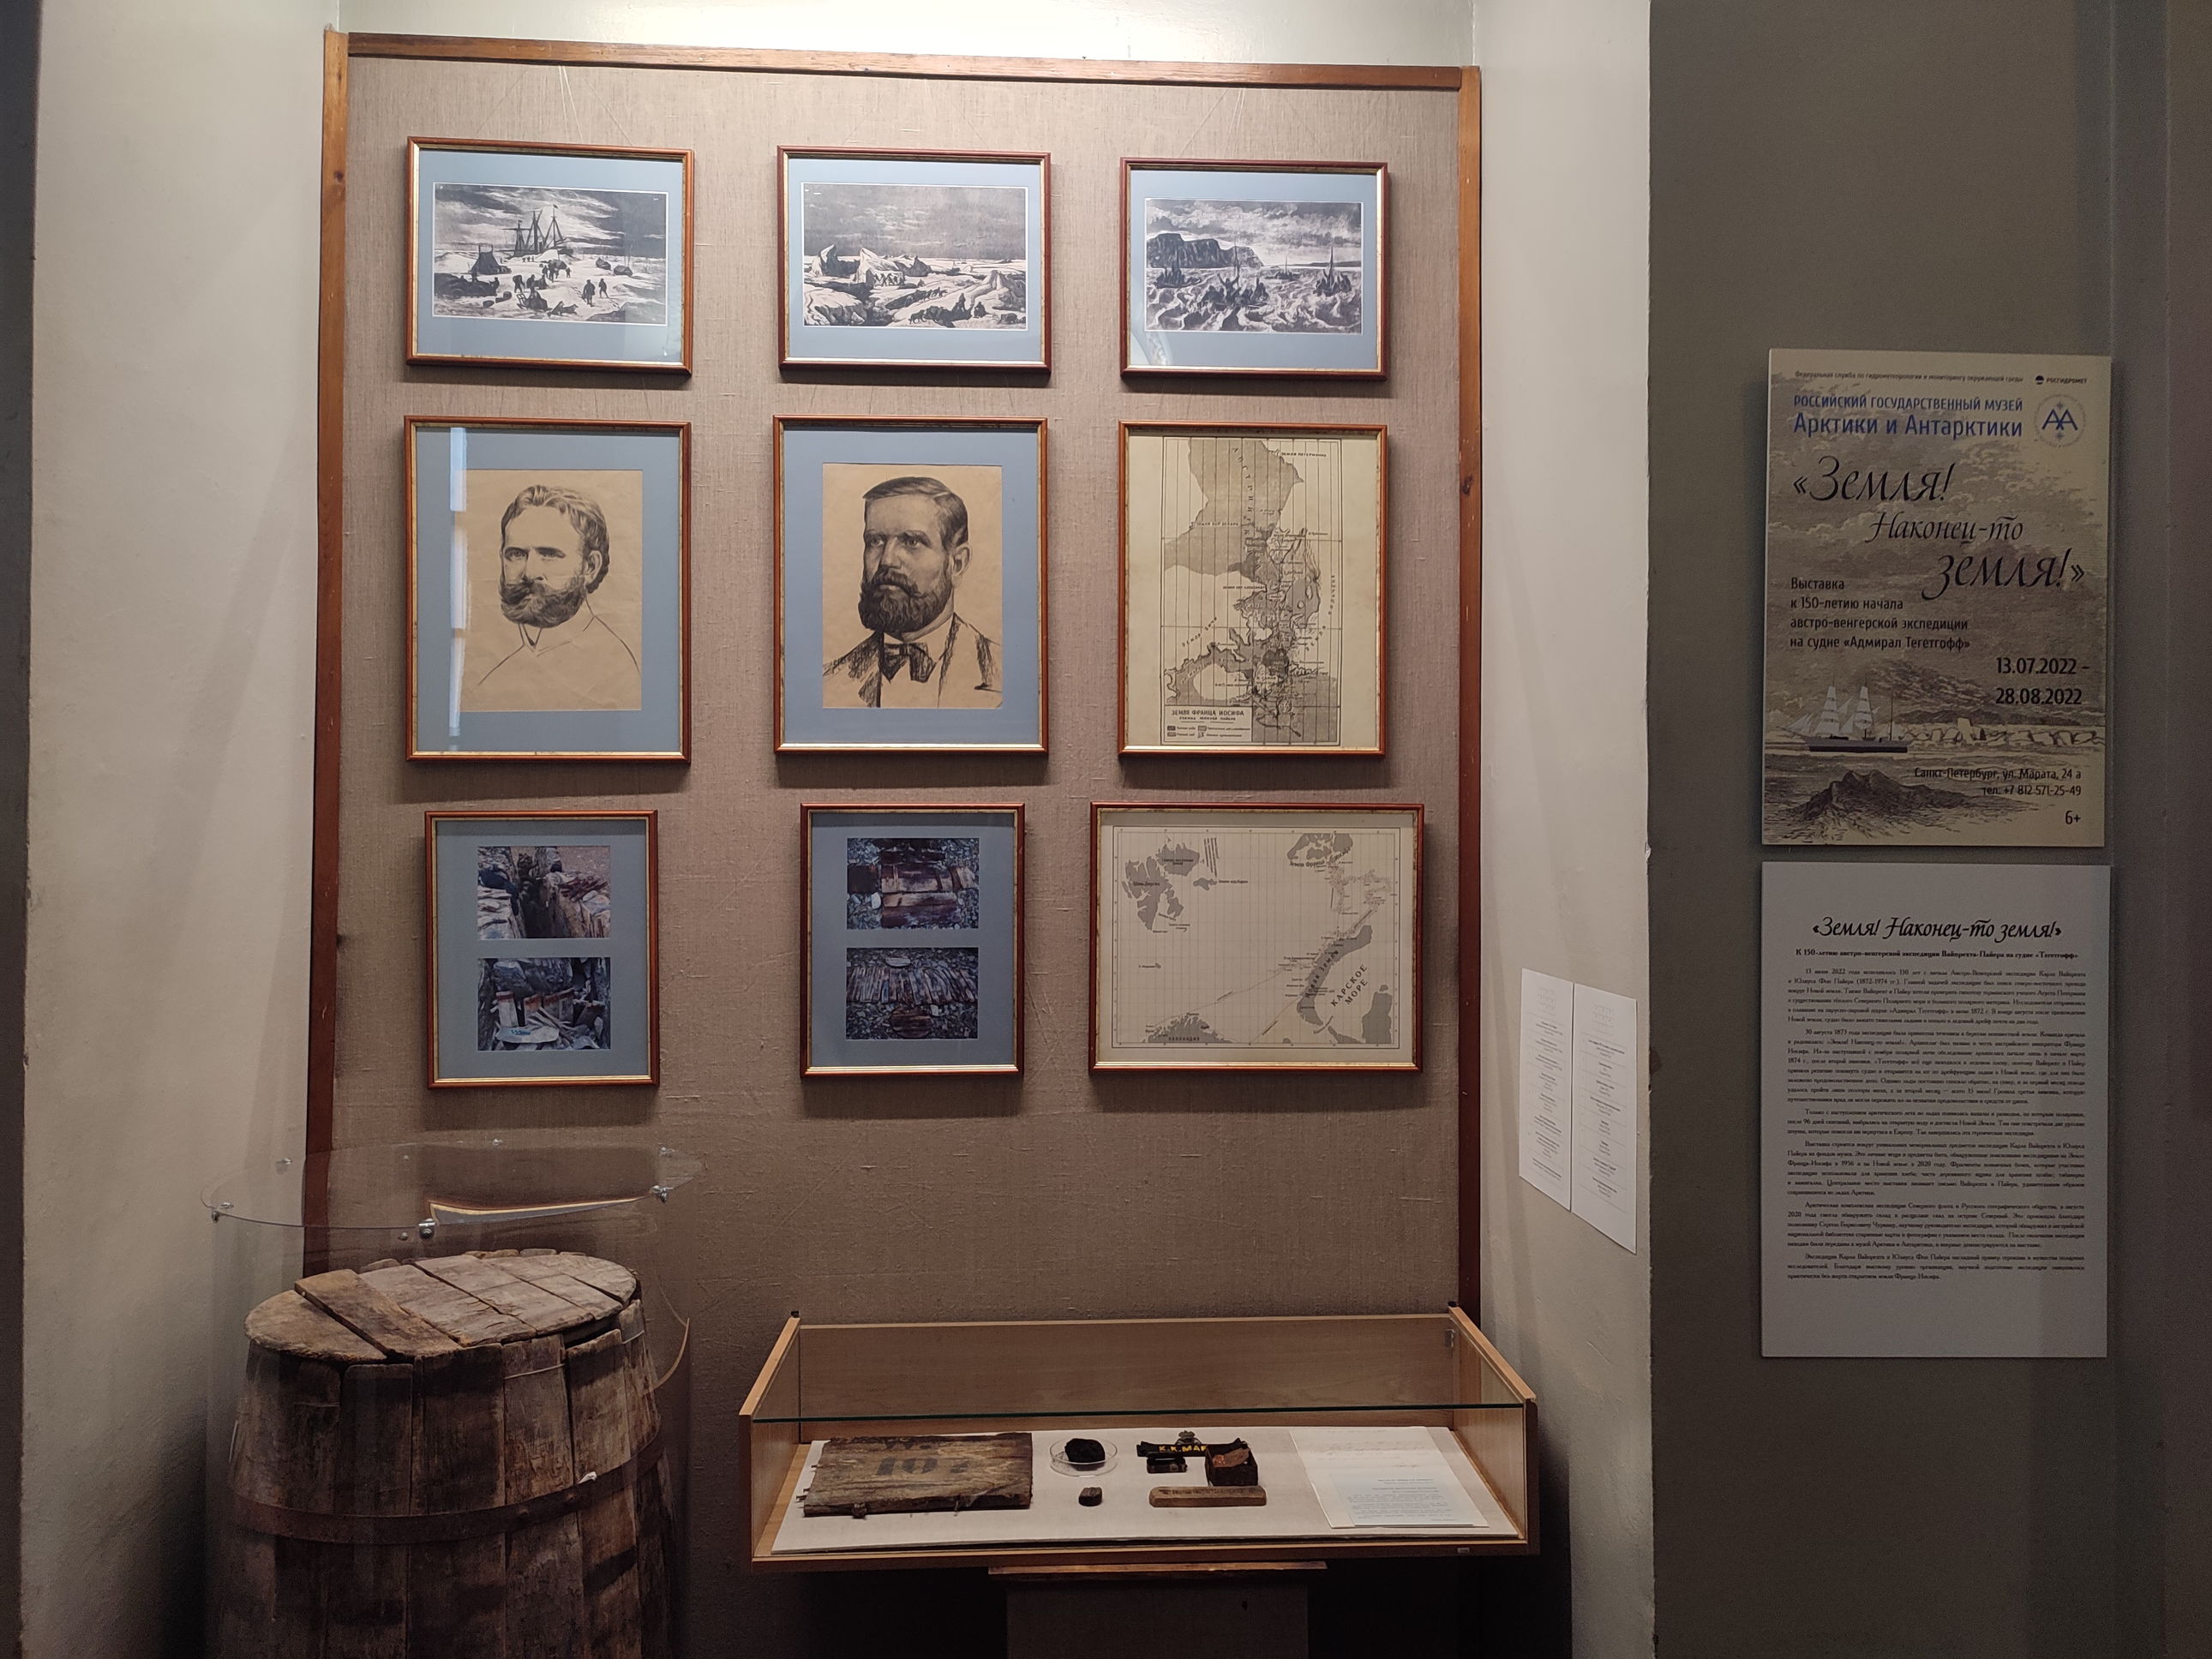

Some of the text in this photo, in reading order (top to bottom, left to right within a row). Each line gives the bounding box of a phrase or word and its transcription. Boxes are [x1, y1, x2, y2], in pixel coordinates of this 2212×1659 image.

[1794, 394, 2023, 411] РОССИЙСКИЙ ГОСУДАРСТВЕННЫЙ МУЗЕЙ
[1794, 412, 1878, 438] Арктики
[1886, 419, 1897, 434] и
[1905, 415, 2023, 440] Антарктики
[1794, 455, 1956, 501] «Земля!
[1865, 512, 2023, 548] Наконец-то
[1921, 548, 2084, 601] земля!»
[1790, 577, 1844, 590] Выставка
[1790, 596, 1903, 609] к 150-летию начала
[1790, 617, 1968, 632] австро-венгерской экспедиции
[1790, 636, 1970, 651] на судне «Адмирал Тегетгофф»
[1996, 657, 2077, 674] 13.07.2022
[1995, 687, 2083, 705] 28.08.2022
[1915, 767, 1999, 781] Санкт-Петербург,
[2002, 770, 2017, 781] ул.
[2018, 768, 2059, 781] Марата,
[2061, 769, 2073, 779] 24
[2004, 785, 2014, 795] +7
[2017, 785, 2032, 795] 812
[2035, 785, 2082, 796] 571-25-49
[2065, 810, 2081, 824] 6+
[1813, 916, 2062, 943] «Земля! Наконец-то земля!»
[1330, 964, 1367, 1007] КАРСКОЕ
[1345, 979, 1368, 1004] МОРЕ
